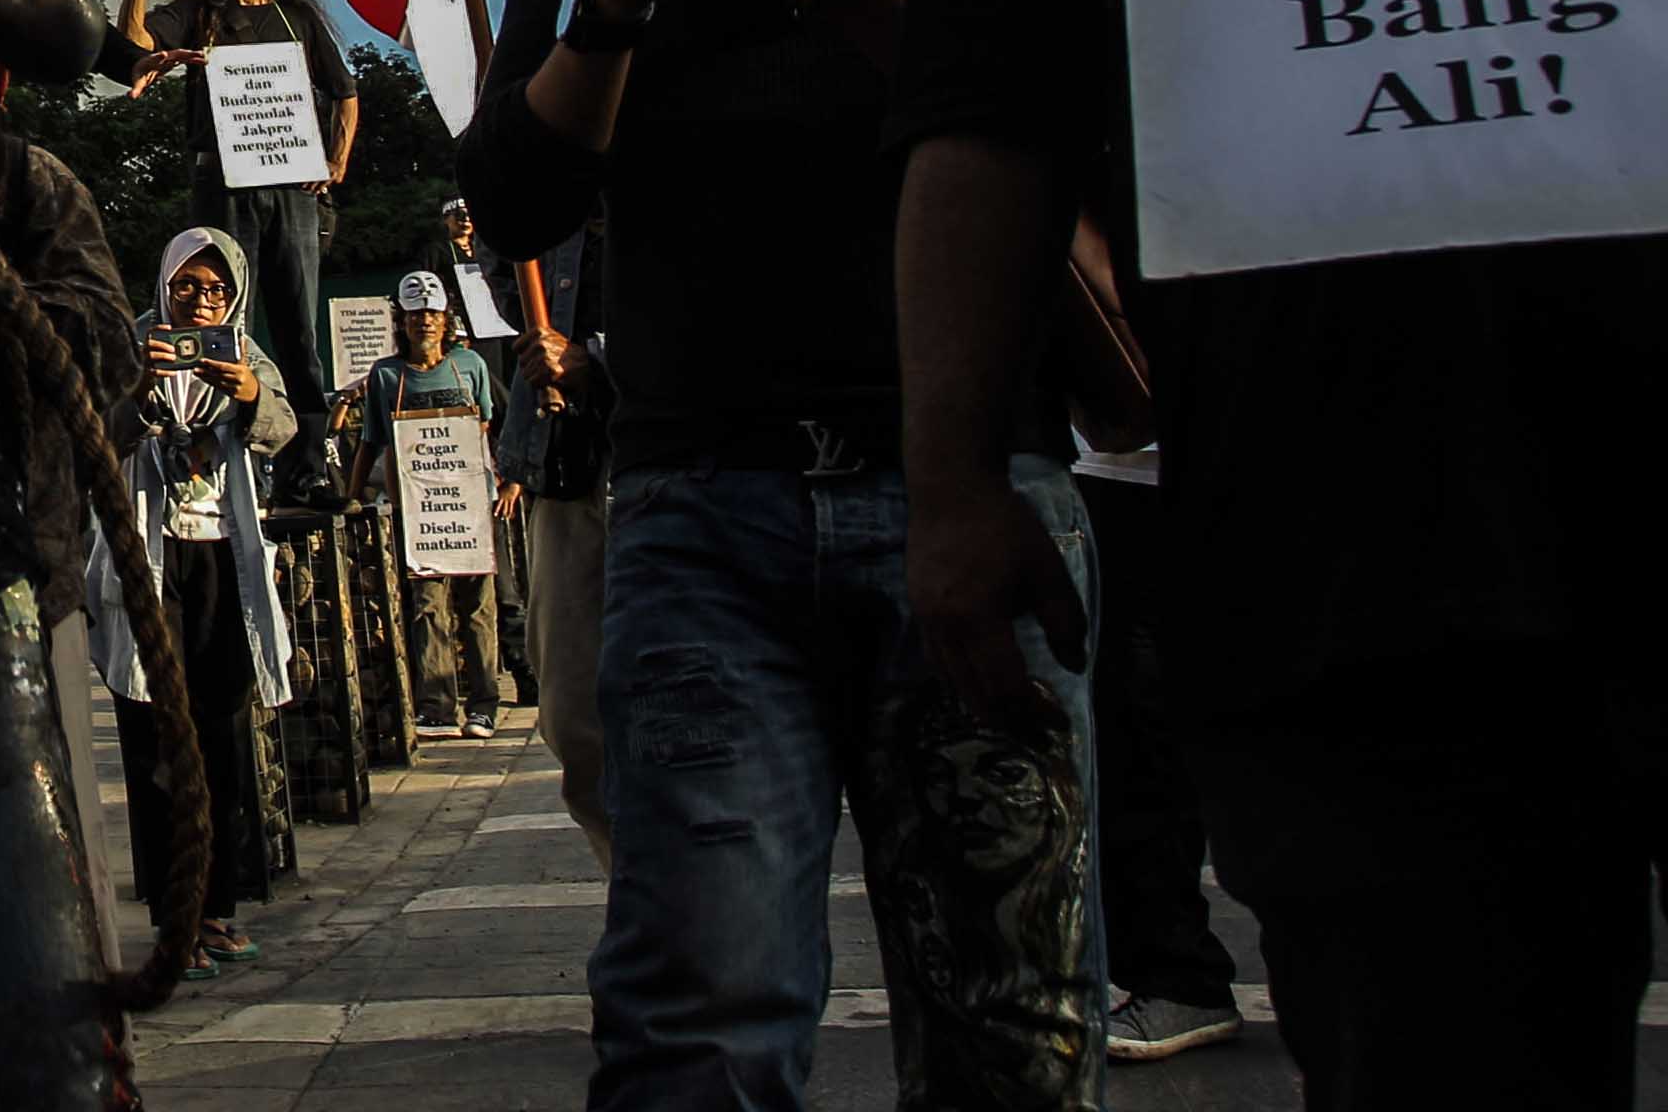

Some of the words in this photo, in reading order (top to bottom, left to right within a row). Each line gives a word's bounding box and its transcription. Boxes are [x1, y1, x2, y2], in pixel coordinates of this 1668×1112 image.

[223, 62, 287, 76] Seniman
[244, 78, 271, 90] dan
[219, 92, 304, 107] Budayawan
[1345, 53, 1572, 136] Ali!
[232, 106, 295, 122] menolak
[241, 123, 292, 137] Jakpro
[232, 135, 308, 153] mengelola
[258, 153, 289, 166] TIM
[418, 426, 450, 440] TIM
[415, 443, 458, 457] Cagar
[412, 458, 466, 471] Budaya
[424, 486, 460, 499] yang
[421, 500, 467, 513] Harus
[419, 521, 472, 535] Disela-
[416, 537, 477, 551] matkan!
